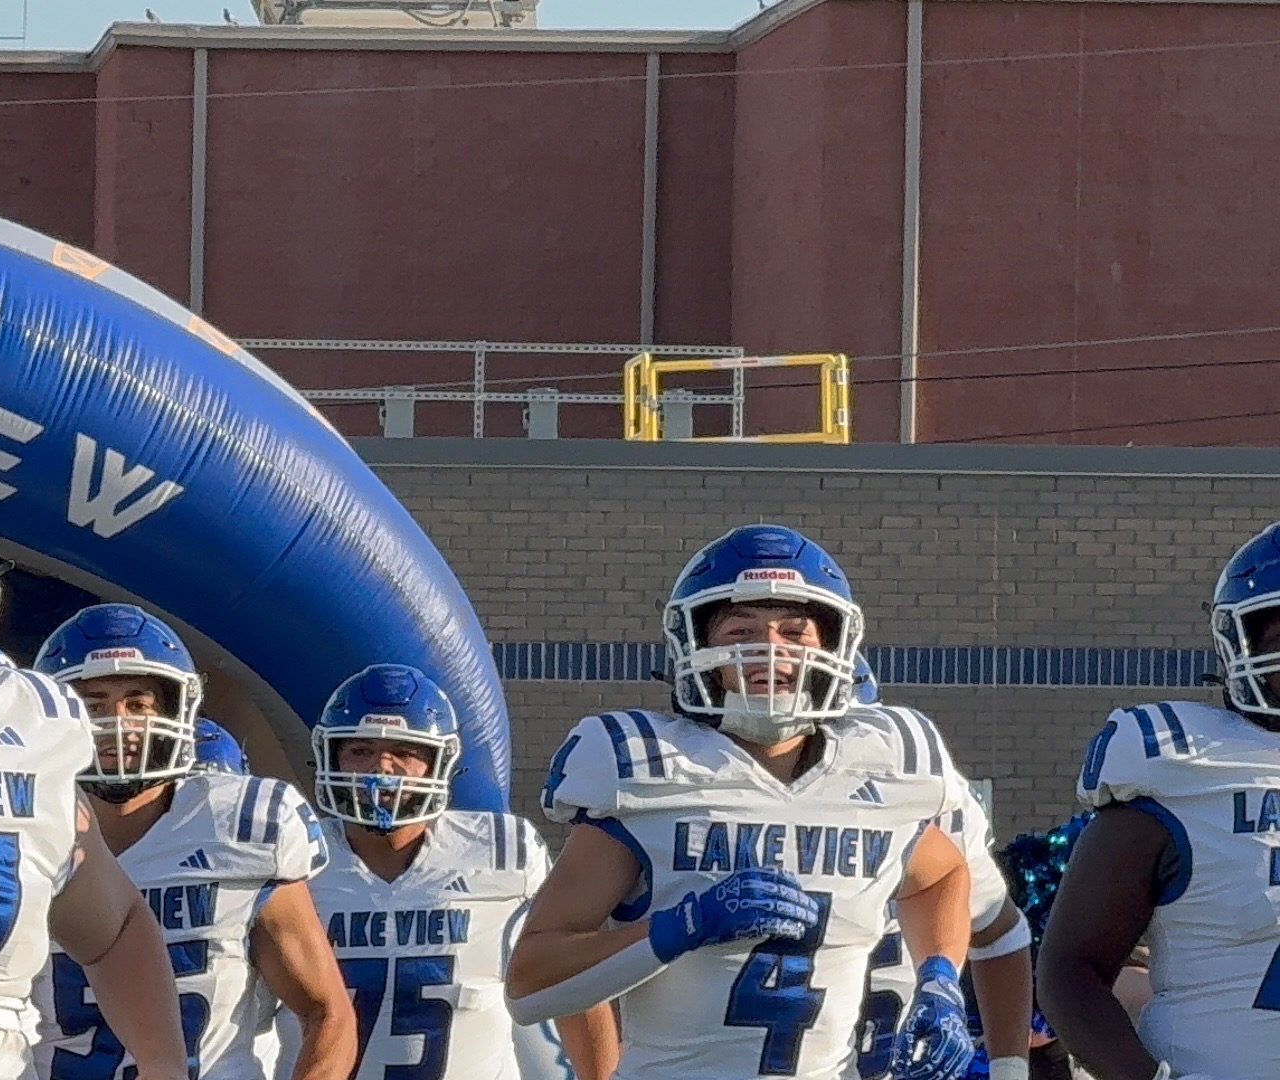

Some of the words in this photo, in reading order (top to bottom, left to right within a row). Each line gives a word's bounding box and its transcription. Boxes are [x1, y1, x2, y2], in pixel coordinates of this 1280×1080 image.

[673, 821, 787, 871] LAKE
[794, 825, 894, 878] VIEW
[141, 881, 220, 930] IEW
[326, 911, 388, 948] AKE
[393, 908, 471, 947] VIEW
[723, 890, 833, 1077] 4
